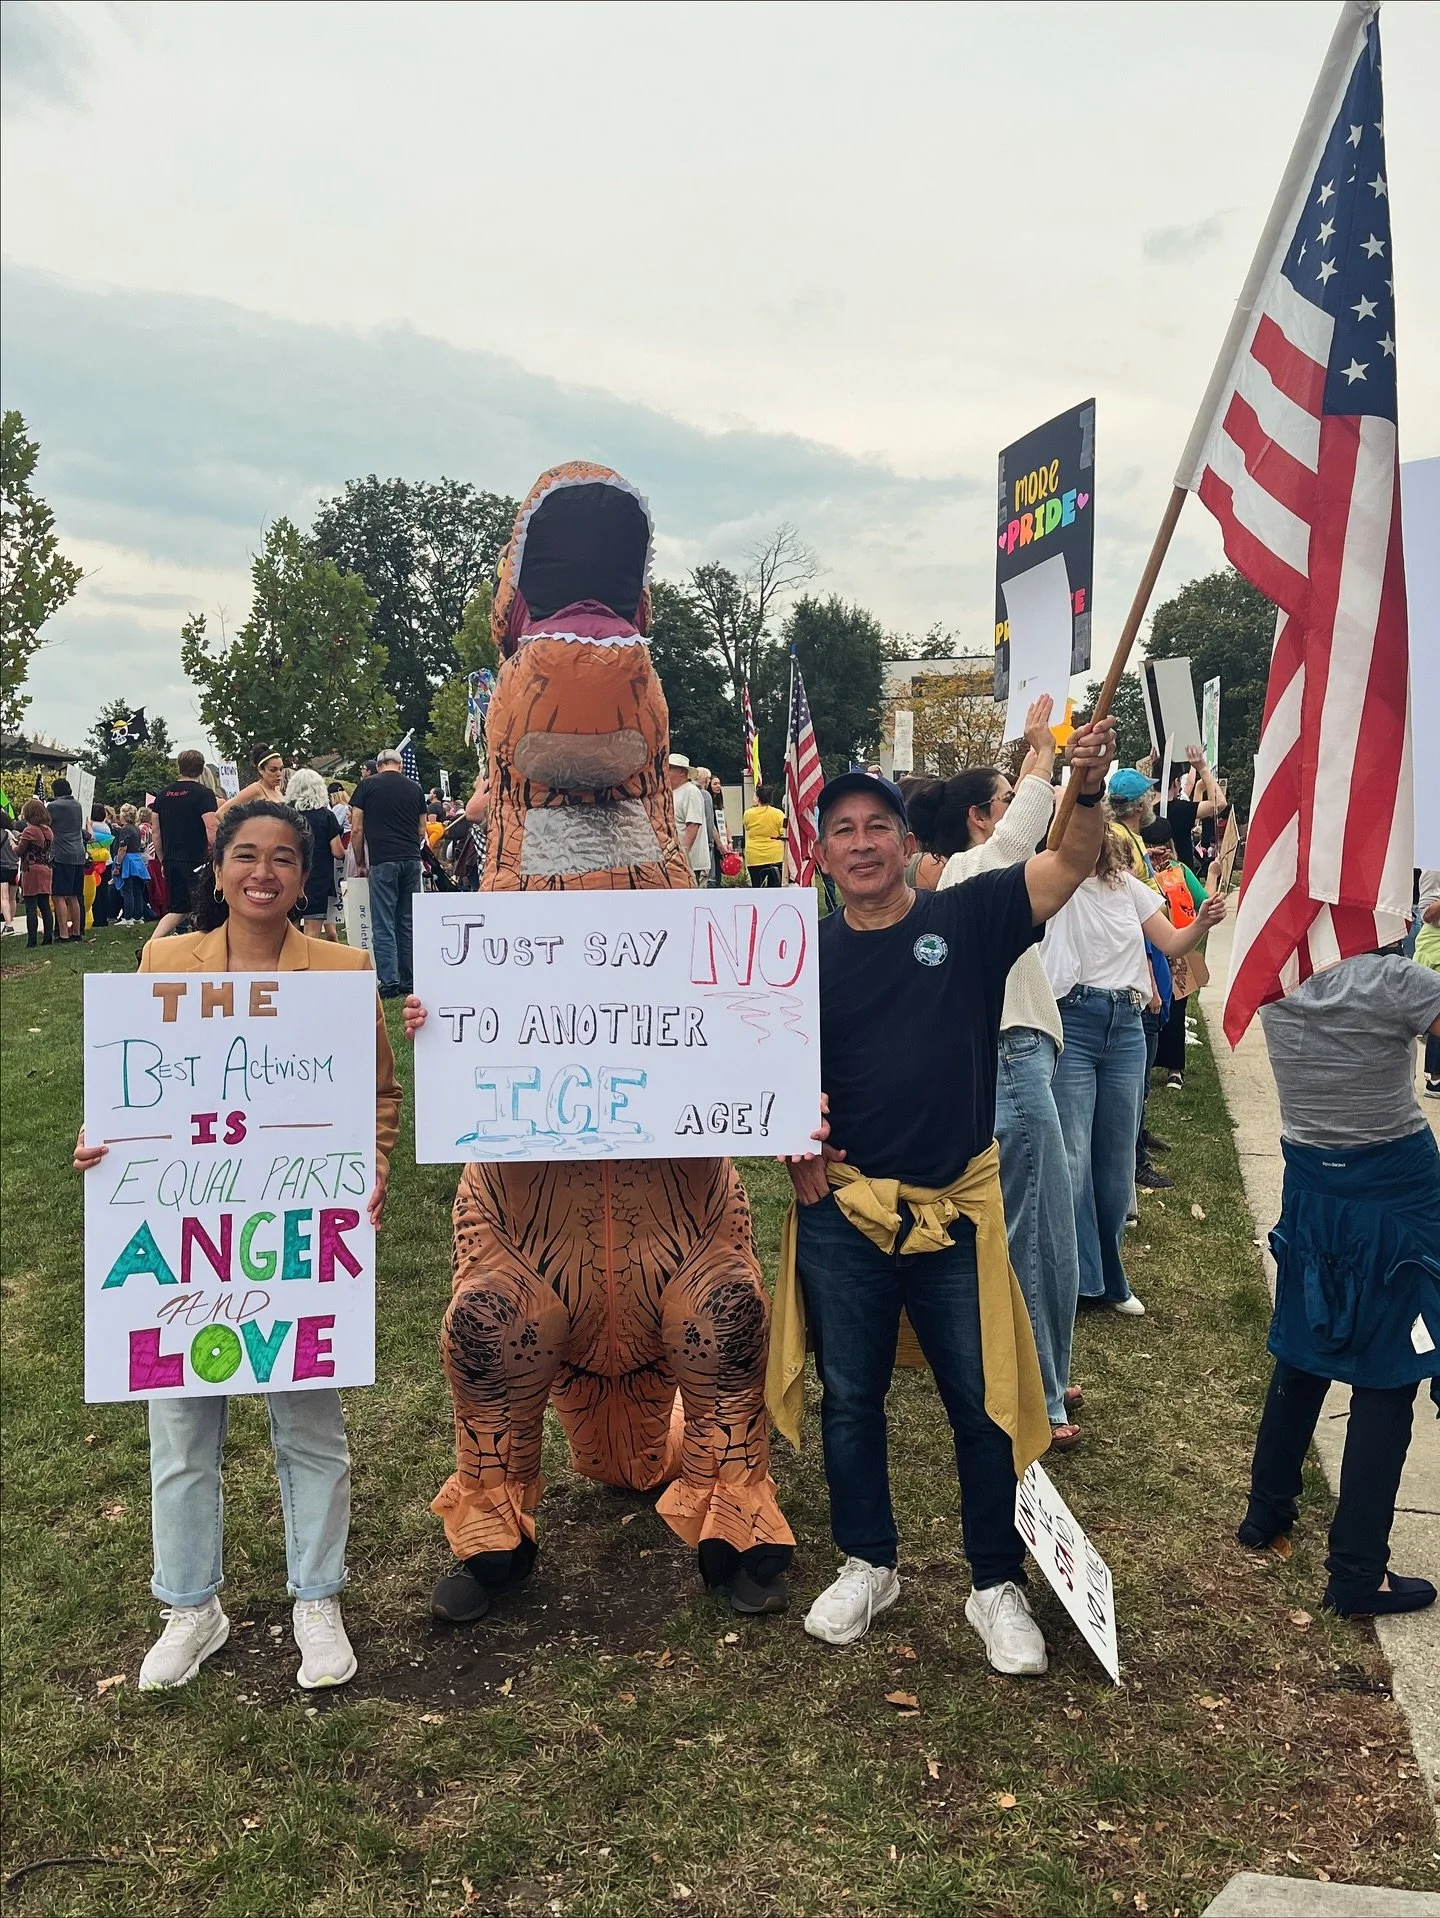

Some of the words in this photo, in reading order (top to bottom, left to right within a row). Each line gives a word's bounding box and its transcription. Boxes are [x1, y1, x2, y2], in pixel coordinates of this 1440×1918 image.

[1007, 487, 1078, 556] PRIDE
[440, 913, 564, 967] JUST
[584, 929, 668, 968] SAY
[689, 903, 808, 988] NO
[152, 980, 279, 1023] THE
[438, 1006, 500, 1044] TO
[517, 1003, 708, 1048] ANOTHER
[189, 1110, 249, 1146] IS
[474, 1063, 648, 1137] ICE
[674, 1091, 775, 1138] AGE!
[109, 1158, 247, 1212] EQUAL
[260, 1151, 367, 1201] PARTS
[101, 1207, 364, 1290] ANGER
[157, 1289, 271, 1326] AND
[128, 1314, 337, 1393] LOVE
[1053, 1515, 1076, 1594] STAND
[1086, 1591, 1107, 1648] NO
